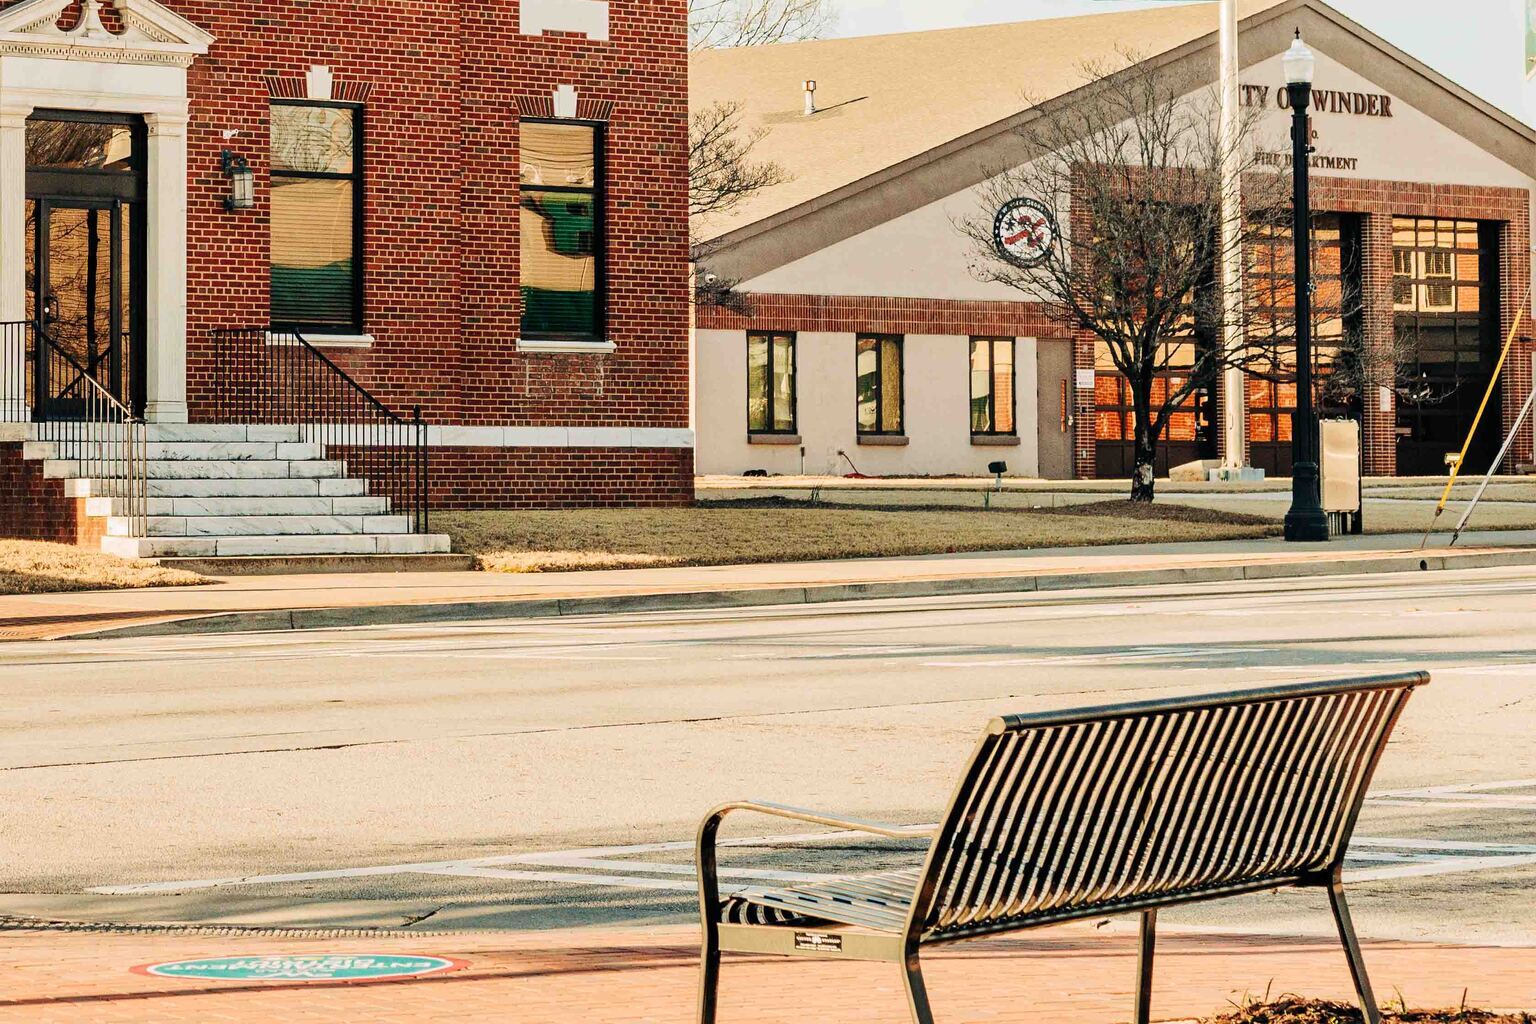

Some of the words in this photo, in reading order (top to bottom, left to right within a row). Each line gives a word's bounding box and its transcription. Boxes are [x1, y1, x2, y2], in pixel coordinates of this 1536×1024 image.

[1238, 84, 1270, 108] ITY
[1311, 89, 1393, 118] WINDER
[1284, 154, 1358, 170] DRTMENT
